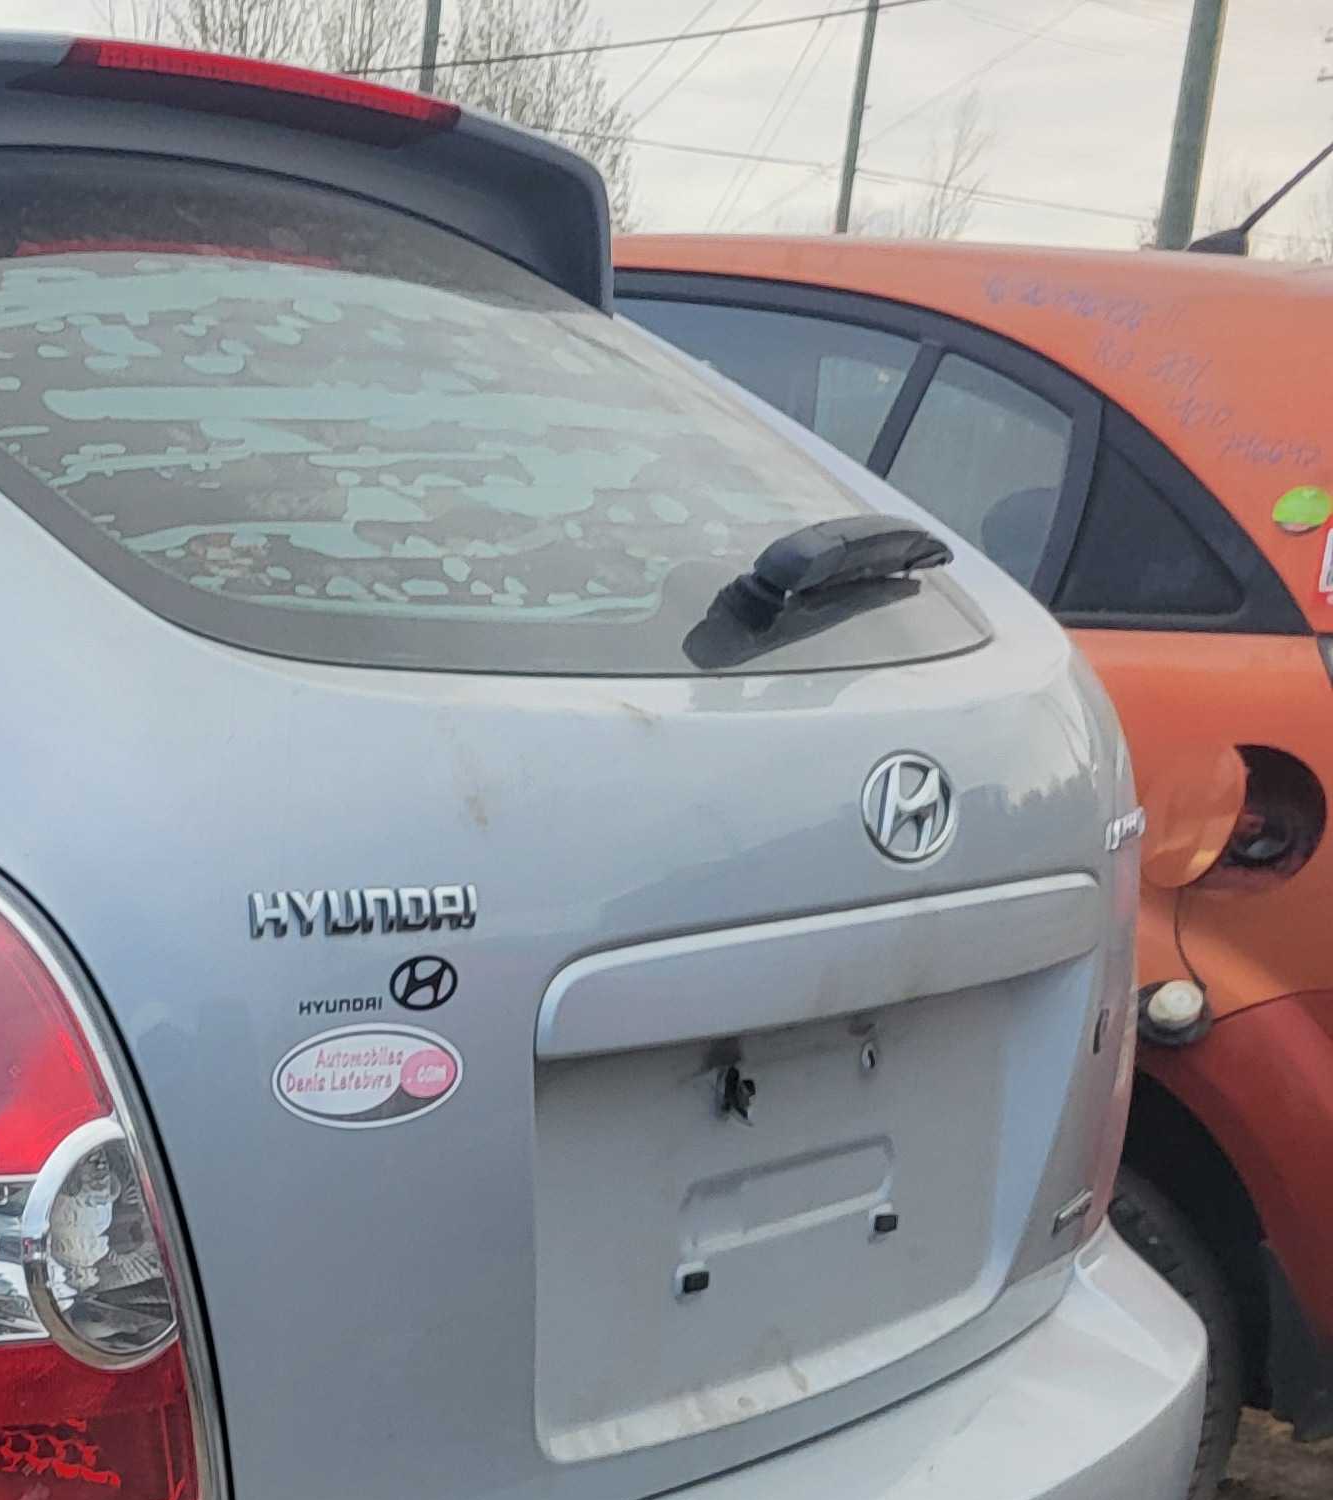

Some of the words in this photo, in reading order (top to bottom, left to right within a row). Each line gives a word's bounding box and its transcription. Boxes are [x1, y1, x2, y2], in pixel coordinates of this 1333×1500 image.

[248, 885, 479, 939] HYUNDAI
[298, 996, 383, 1016] HYUNDAI
[315, 1047, 405, 1069] Automobiles
[285, 1072, 326, 1094] Denis
[329, 1070, 393, 1092] Lefebvre
